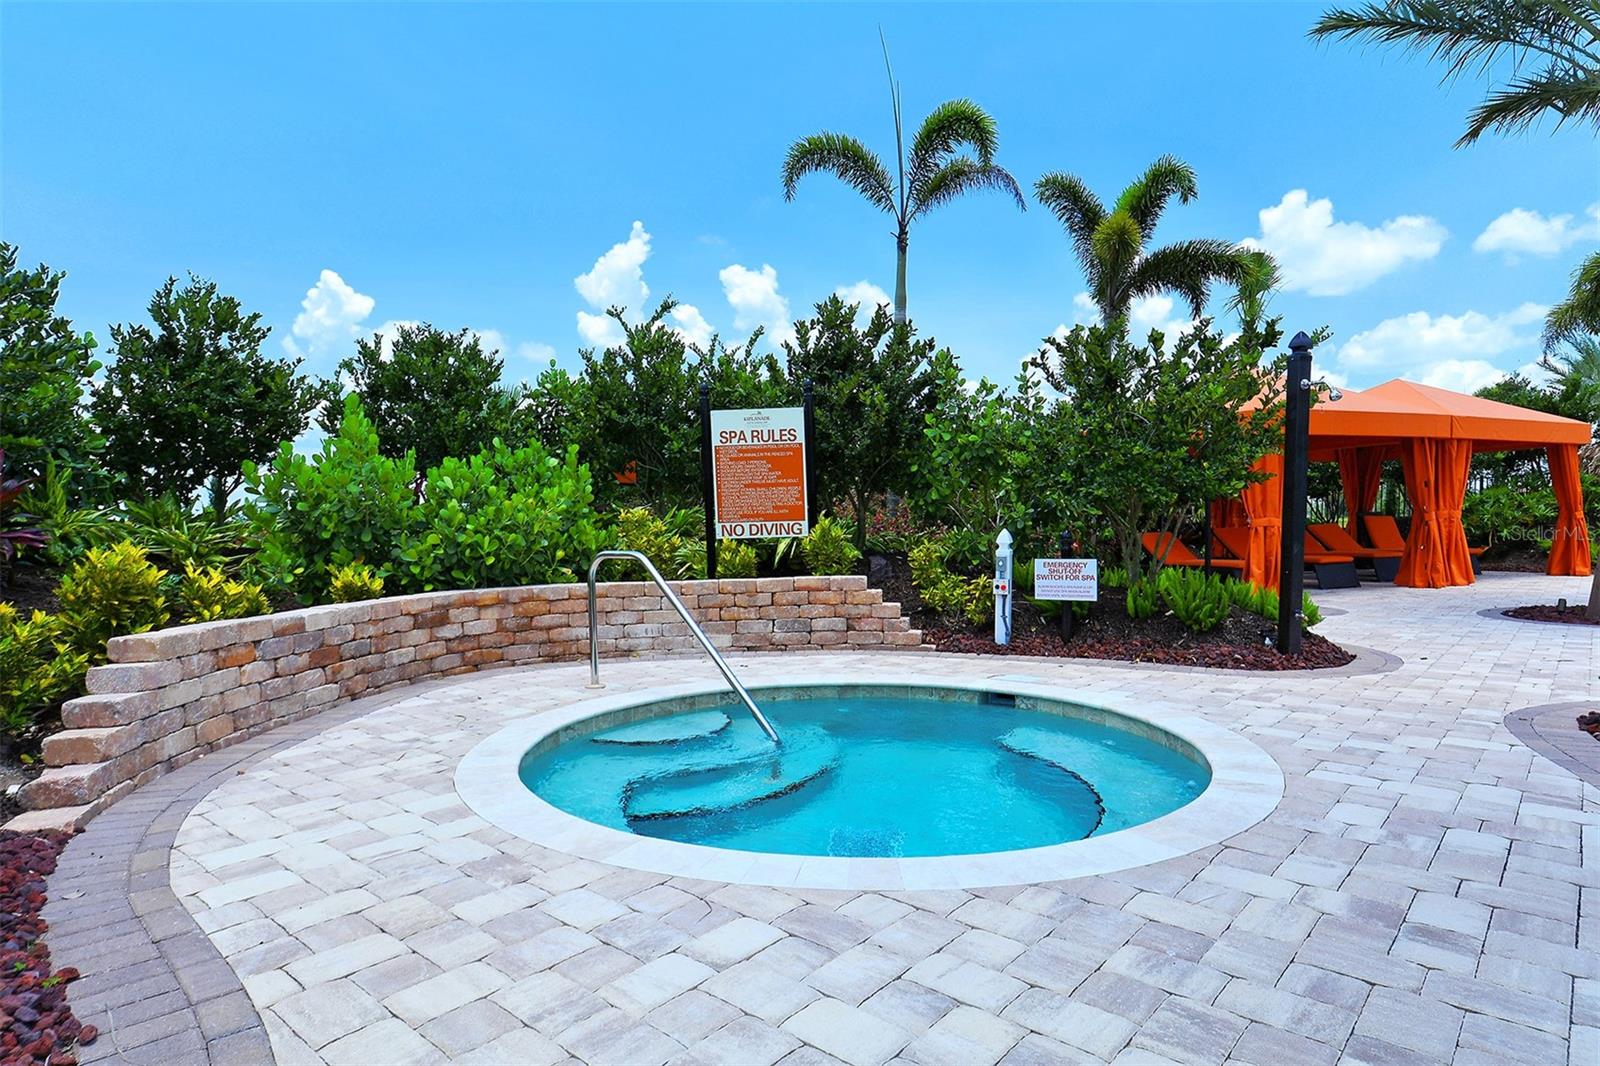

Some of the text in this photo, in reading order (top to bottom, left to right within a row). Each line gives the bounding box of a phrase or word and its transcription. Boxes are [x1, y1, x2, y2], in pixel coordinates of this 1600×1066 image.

[719, 428, 798, 444] SPA RULES
[721, 522, 803, 536] NO DIVING
